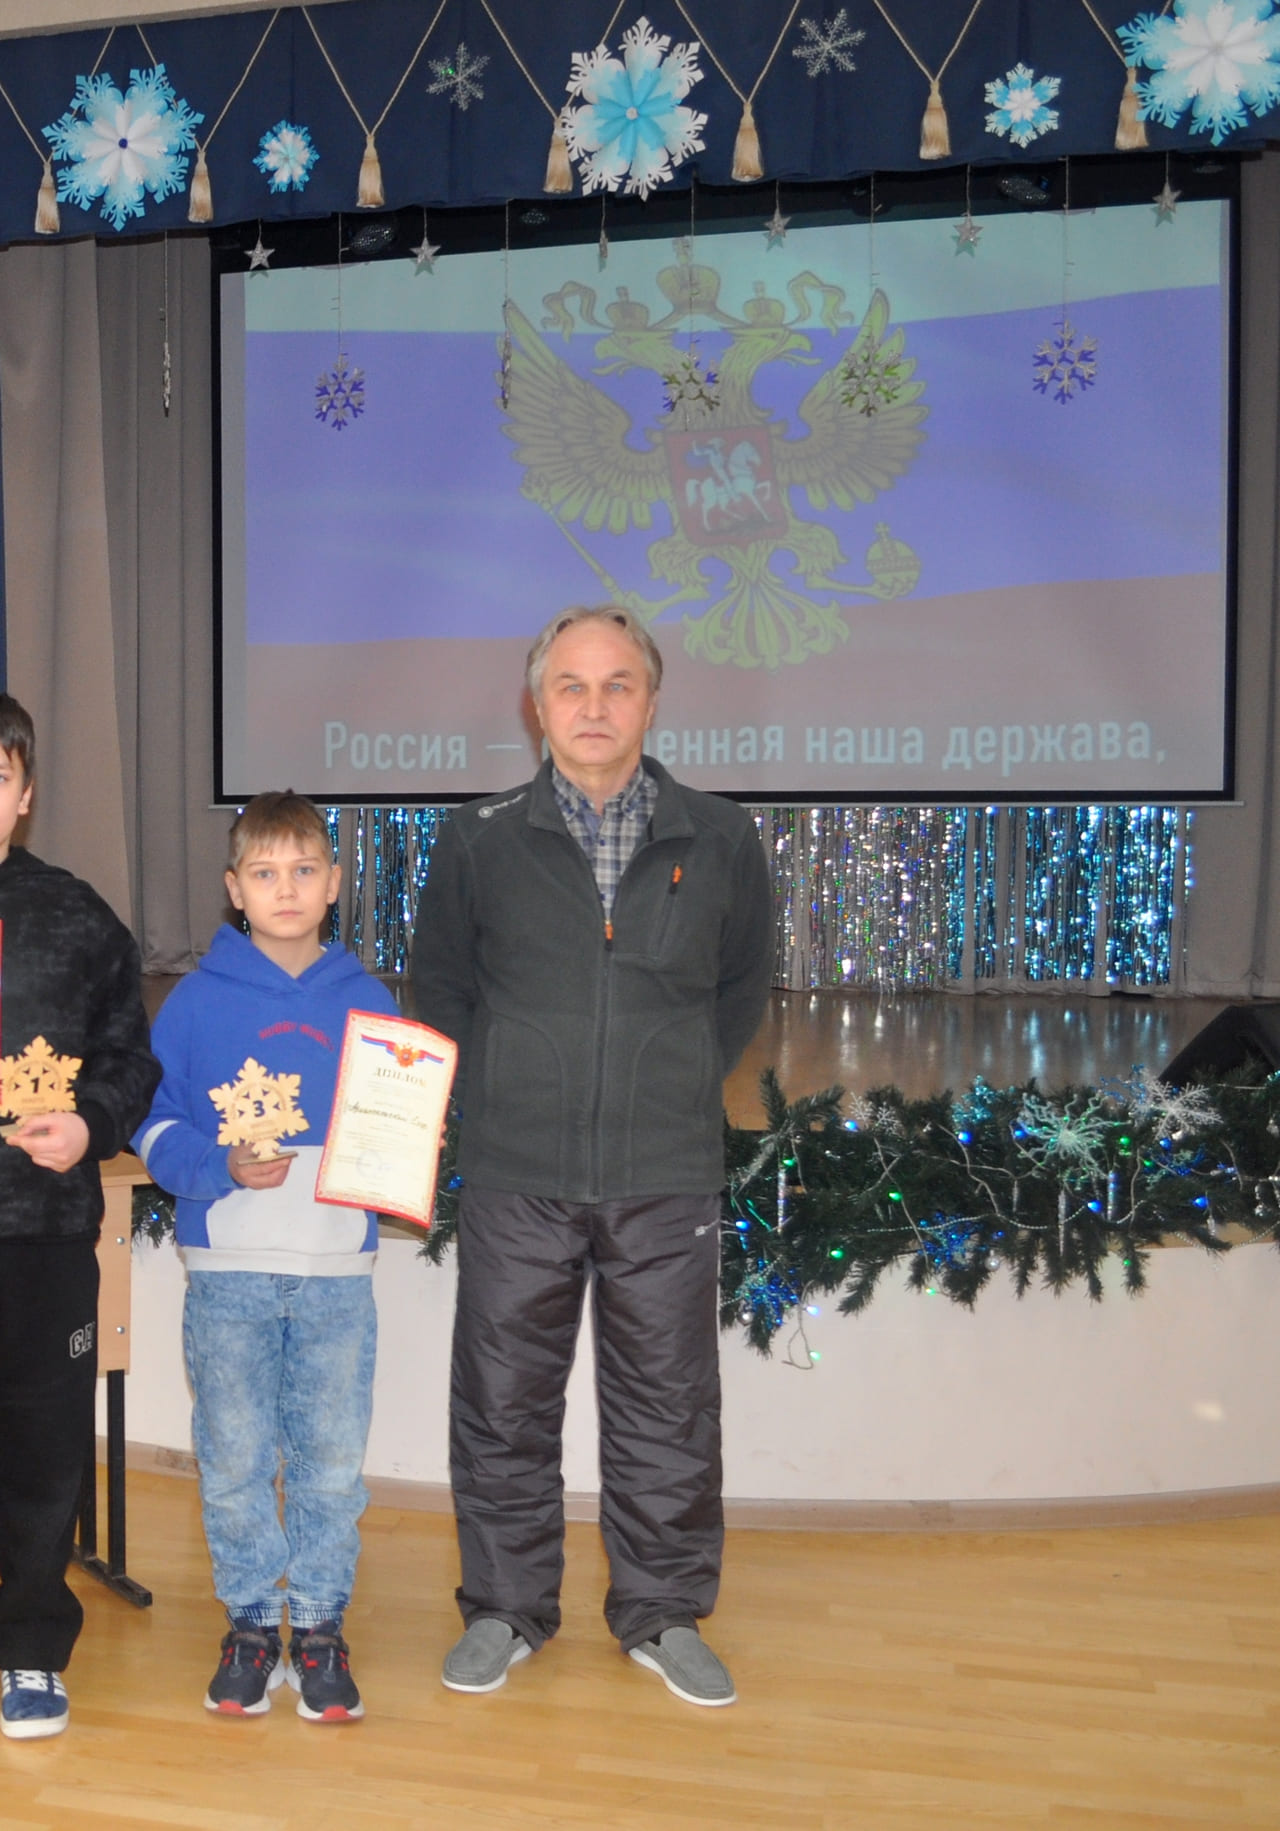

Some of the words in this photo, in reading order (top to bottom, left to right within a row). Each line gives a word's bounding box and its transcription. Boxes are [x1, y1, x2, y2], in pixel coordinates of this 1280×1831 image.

[324, 721, 468, 769] Россия
[805, 725, 926, 764] наша
[942, 720, 1167, 777] держава,
[30, 1077, 41, 1094] 1
[252, 1100, 266, 1118] 3
